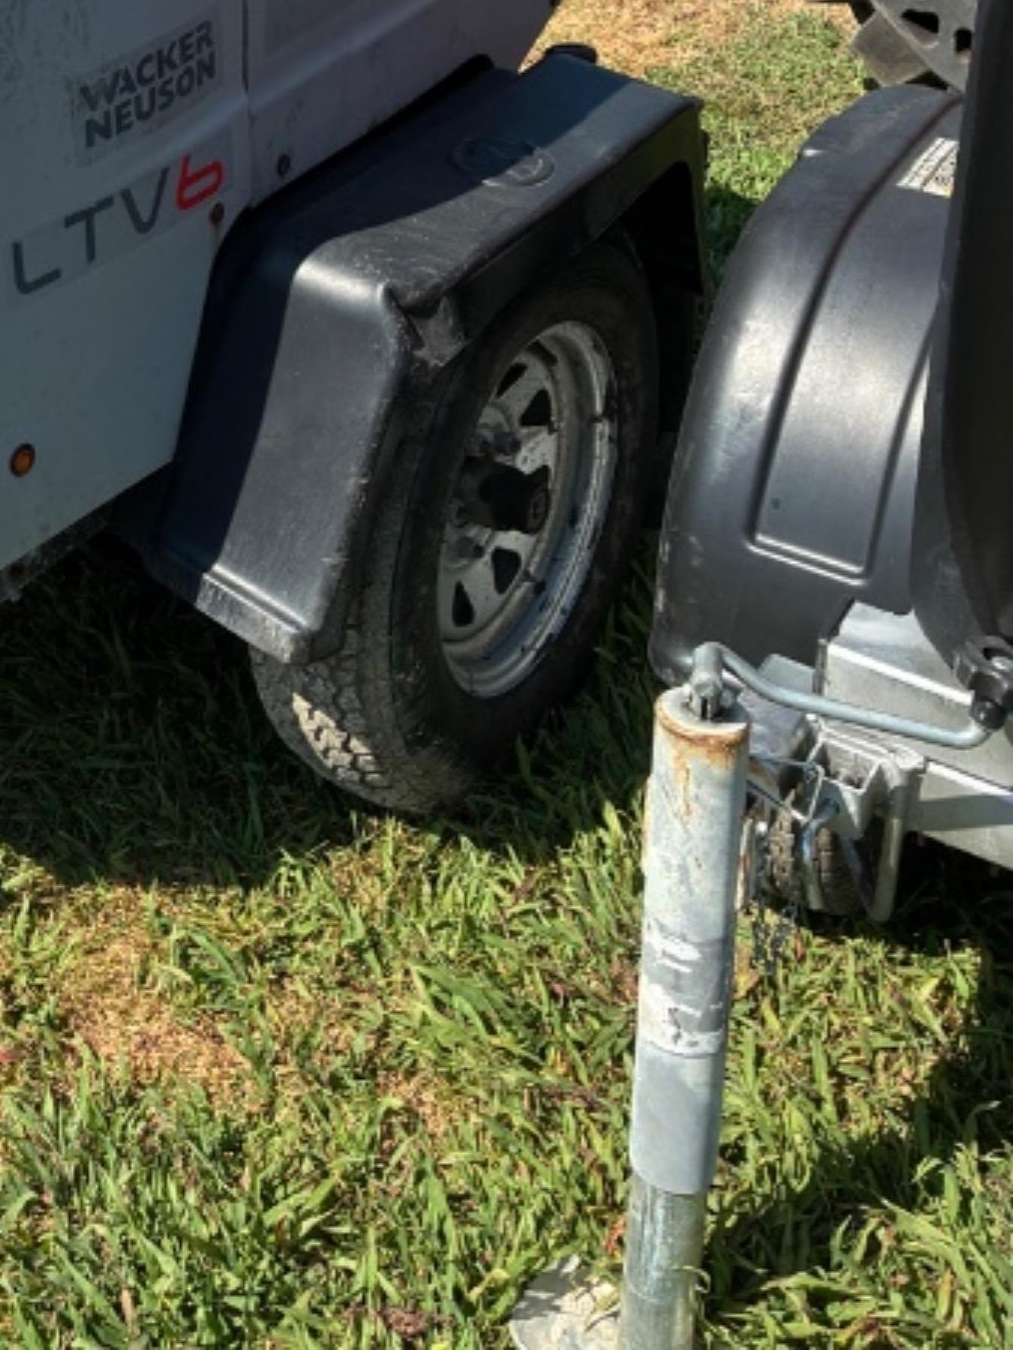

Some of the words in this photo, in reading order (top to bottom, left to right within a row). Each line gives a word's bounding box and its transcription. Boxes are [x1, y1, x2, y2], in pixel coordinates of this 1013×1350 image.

[79, 20, 213, 111] WACKER
[85, 52, 217, 148] NEUSON
[11, 154, 224, 295] LTV6
